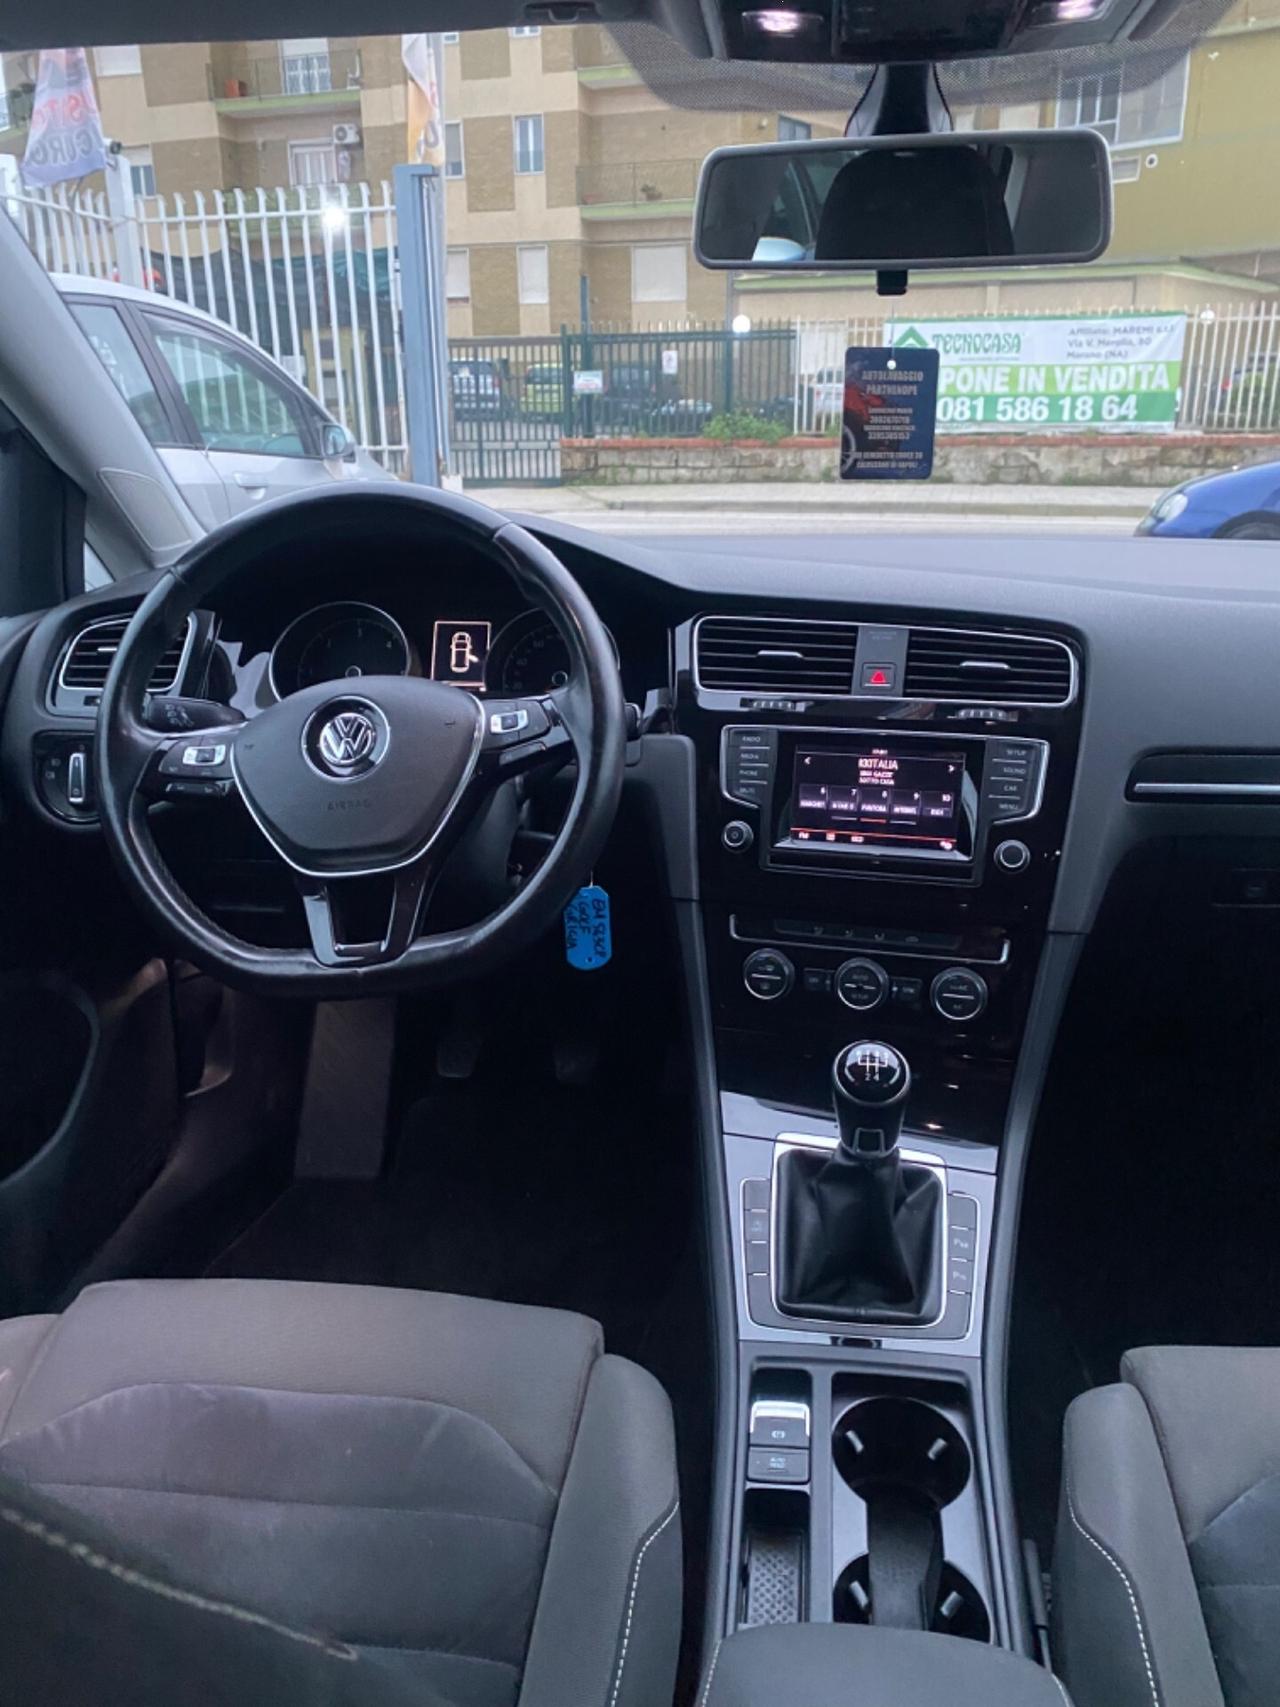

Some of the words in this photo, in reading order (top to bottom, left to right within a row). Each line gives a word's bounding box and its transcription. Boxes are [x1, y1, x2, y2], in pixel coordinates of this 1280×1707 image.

[932, 332, 1022, 354] TECNOCASA
[939, 365, 1013, 393] PONE
[1018, 365, 1045, 392] IN
[1054, 363, 1170, 392] VENDITA
[937, 395, 984, 422] 081
[995, 394, 1049, 421] 586
[1058, 394, 1094, 421] 18
[1102, 394, 1137, 420] 64
